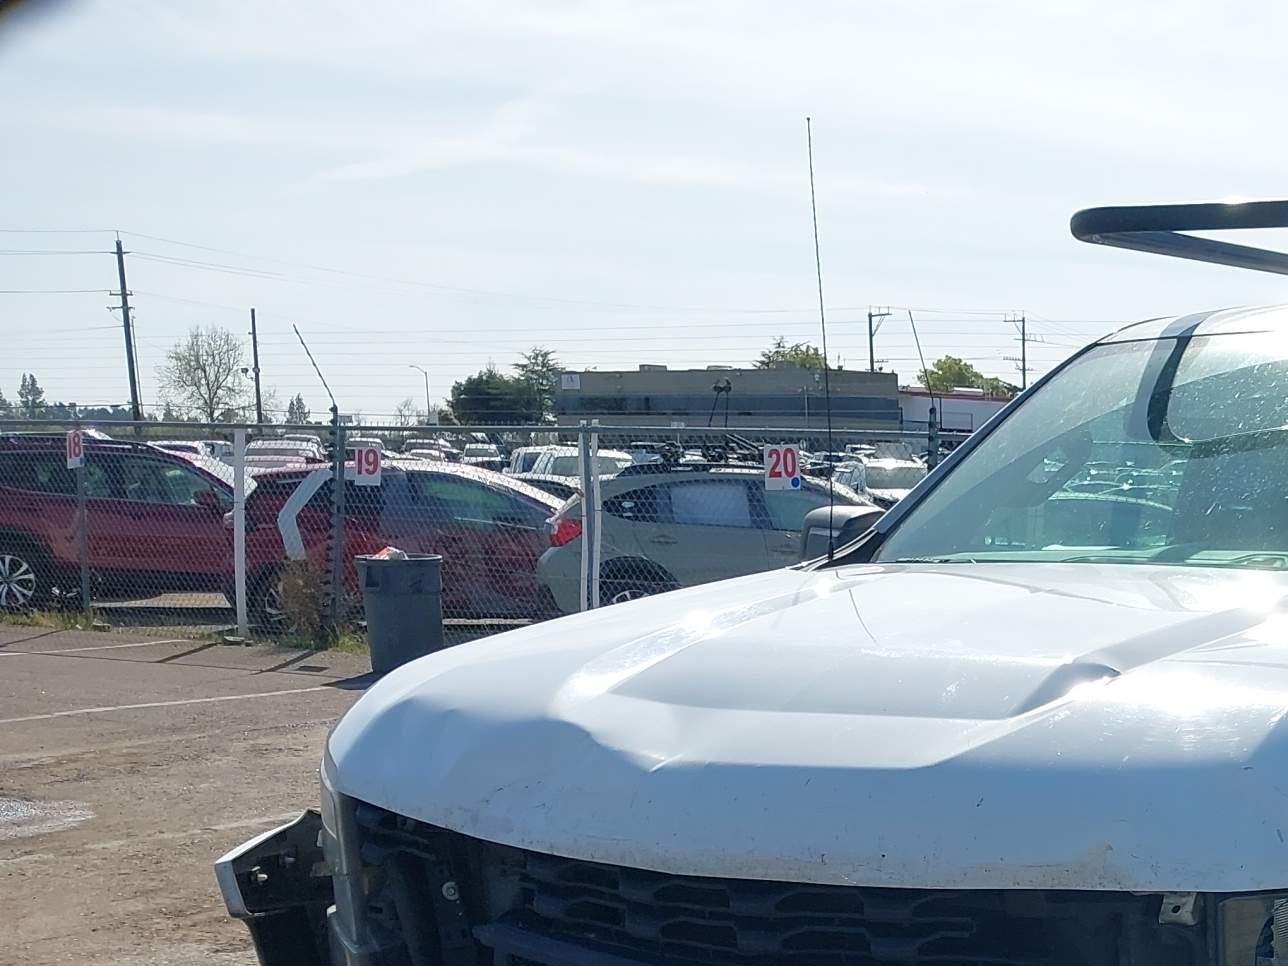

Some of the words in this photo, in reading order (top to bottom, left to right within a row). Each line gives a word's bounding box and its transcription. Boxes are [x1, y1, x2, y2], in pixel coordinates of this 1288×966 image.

[68, 431, 81, 459] 18
[357, 449, 379, 475] 19
[768, 447, 797, 478] 20
